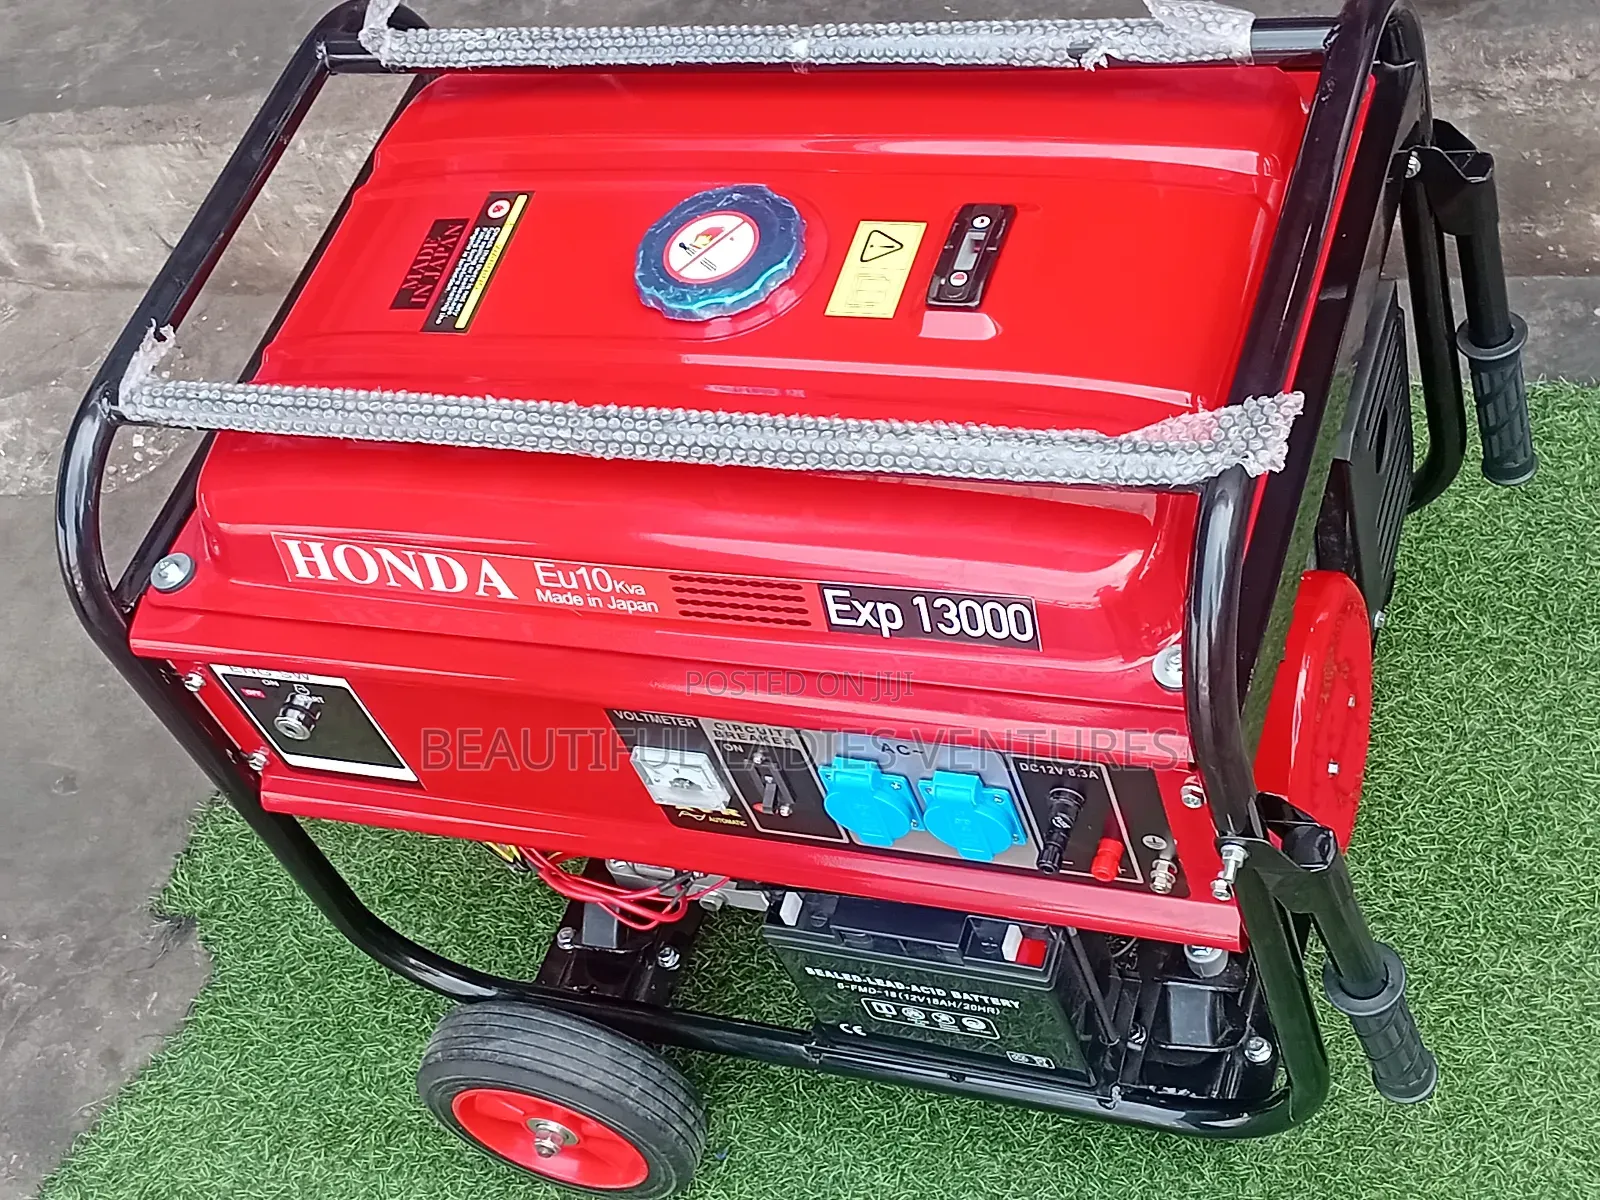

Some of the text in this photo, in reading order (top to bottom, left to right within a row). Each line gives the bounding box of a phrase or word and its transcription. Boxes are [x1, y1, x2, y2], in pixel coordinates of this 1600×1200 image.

[402, 237, 439, 289] MADE
[410, 224, 463, 302] IN JAPAN
[281, 538, 518, 599] HONDA
[535, 587, 660, 615] Made in Japan
[823, 588, 1035, 643] Exp 13000
[261, 678, 280, 688] ON
[613, 710, 698, 729] VOLTMETER
[712, 730, 796, 748] BREAKER
[714, 722, 784, 738] CIRCUIT
[723, 743, 745, 754] ON
[1018, 762, 1100, 780] DC12V 8.3A
[804, 966, 1021, 1010] SEALED-LEAD-ACID BATTERY
[838, 1023, 868, 1037] CE
